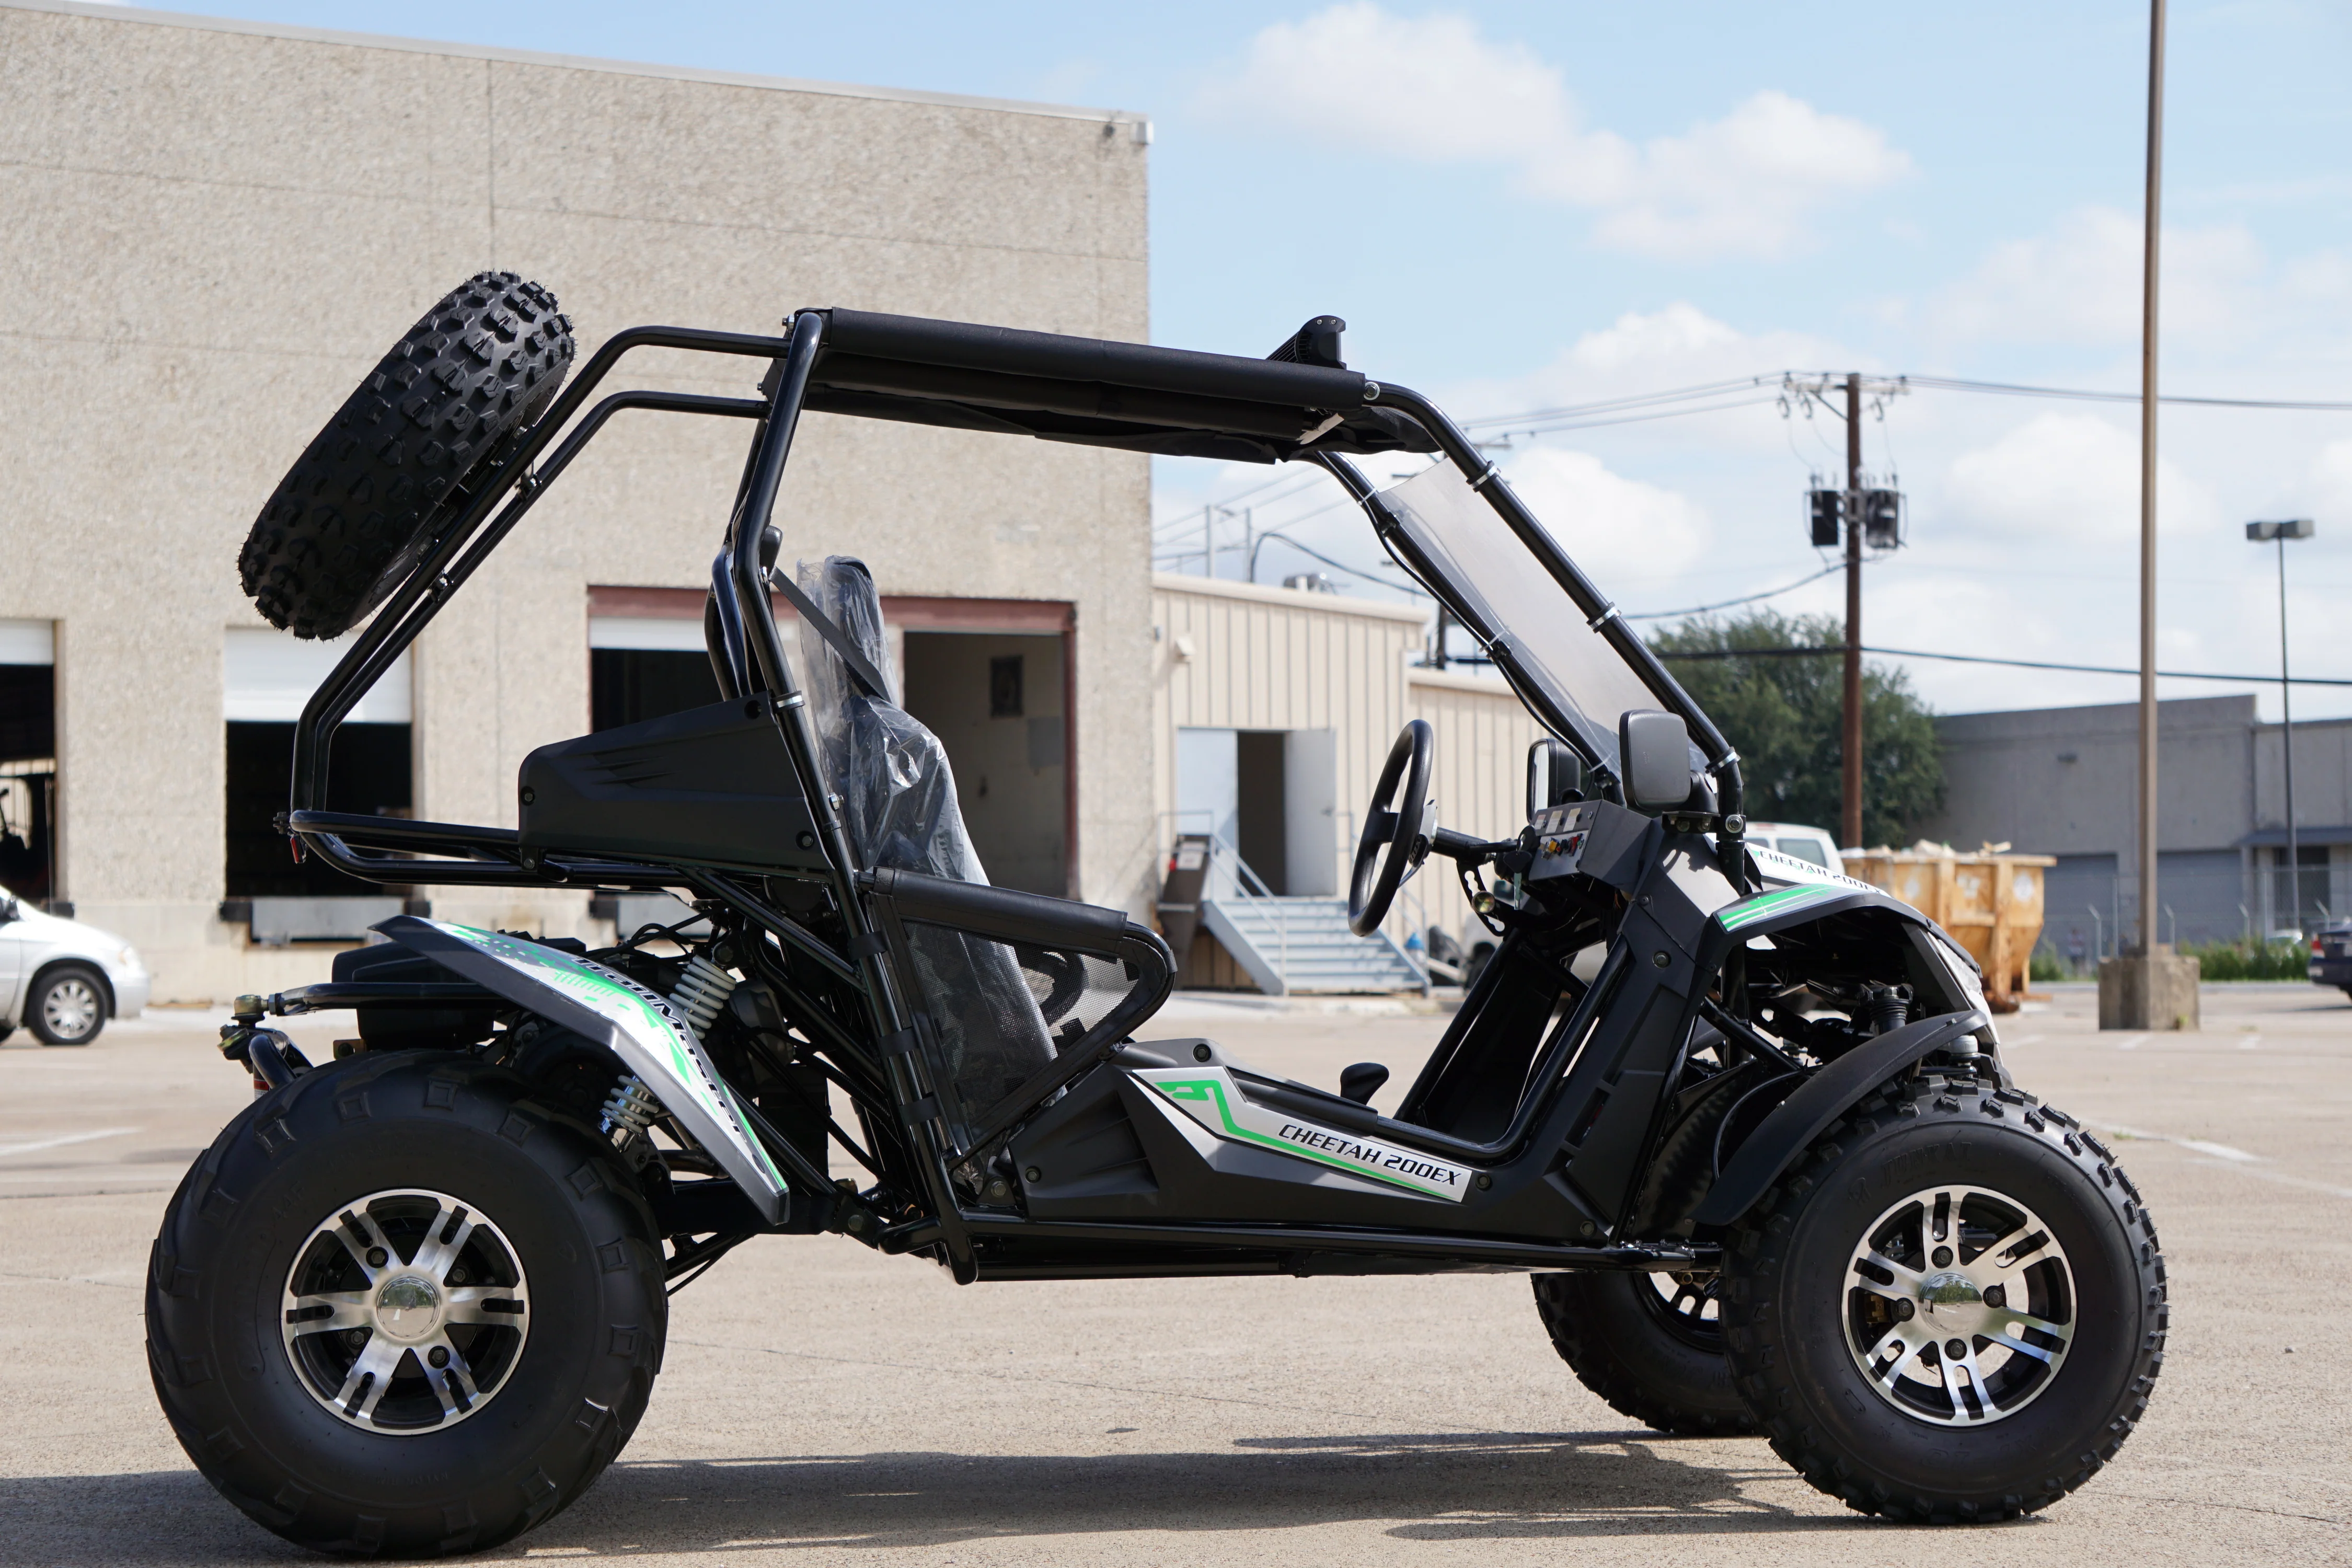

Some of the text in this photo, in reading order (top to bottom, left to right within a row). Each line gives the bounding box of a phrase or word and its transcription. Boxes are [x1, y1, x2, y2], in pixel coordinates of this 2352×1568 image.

[1759, 851, 1828, 877] CHEETAH
[1278, 1124, 1462, 1186] CHEETAH 200EX
